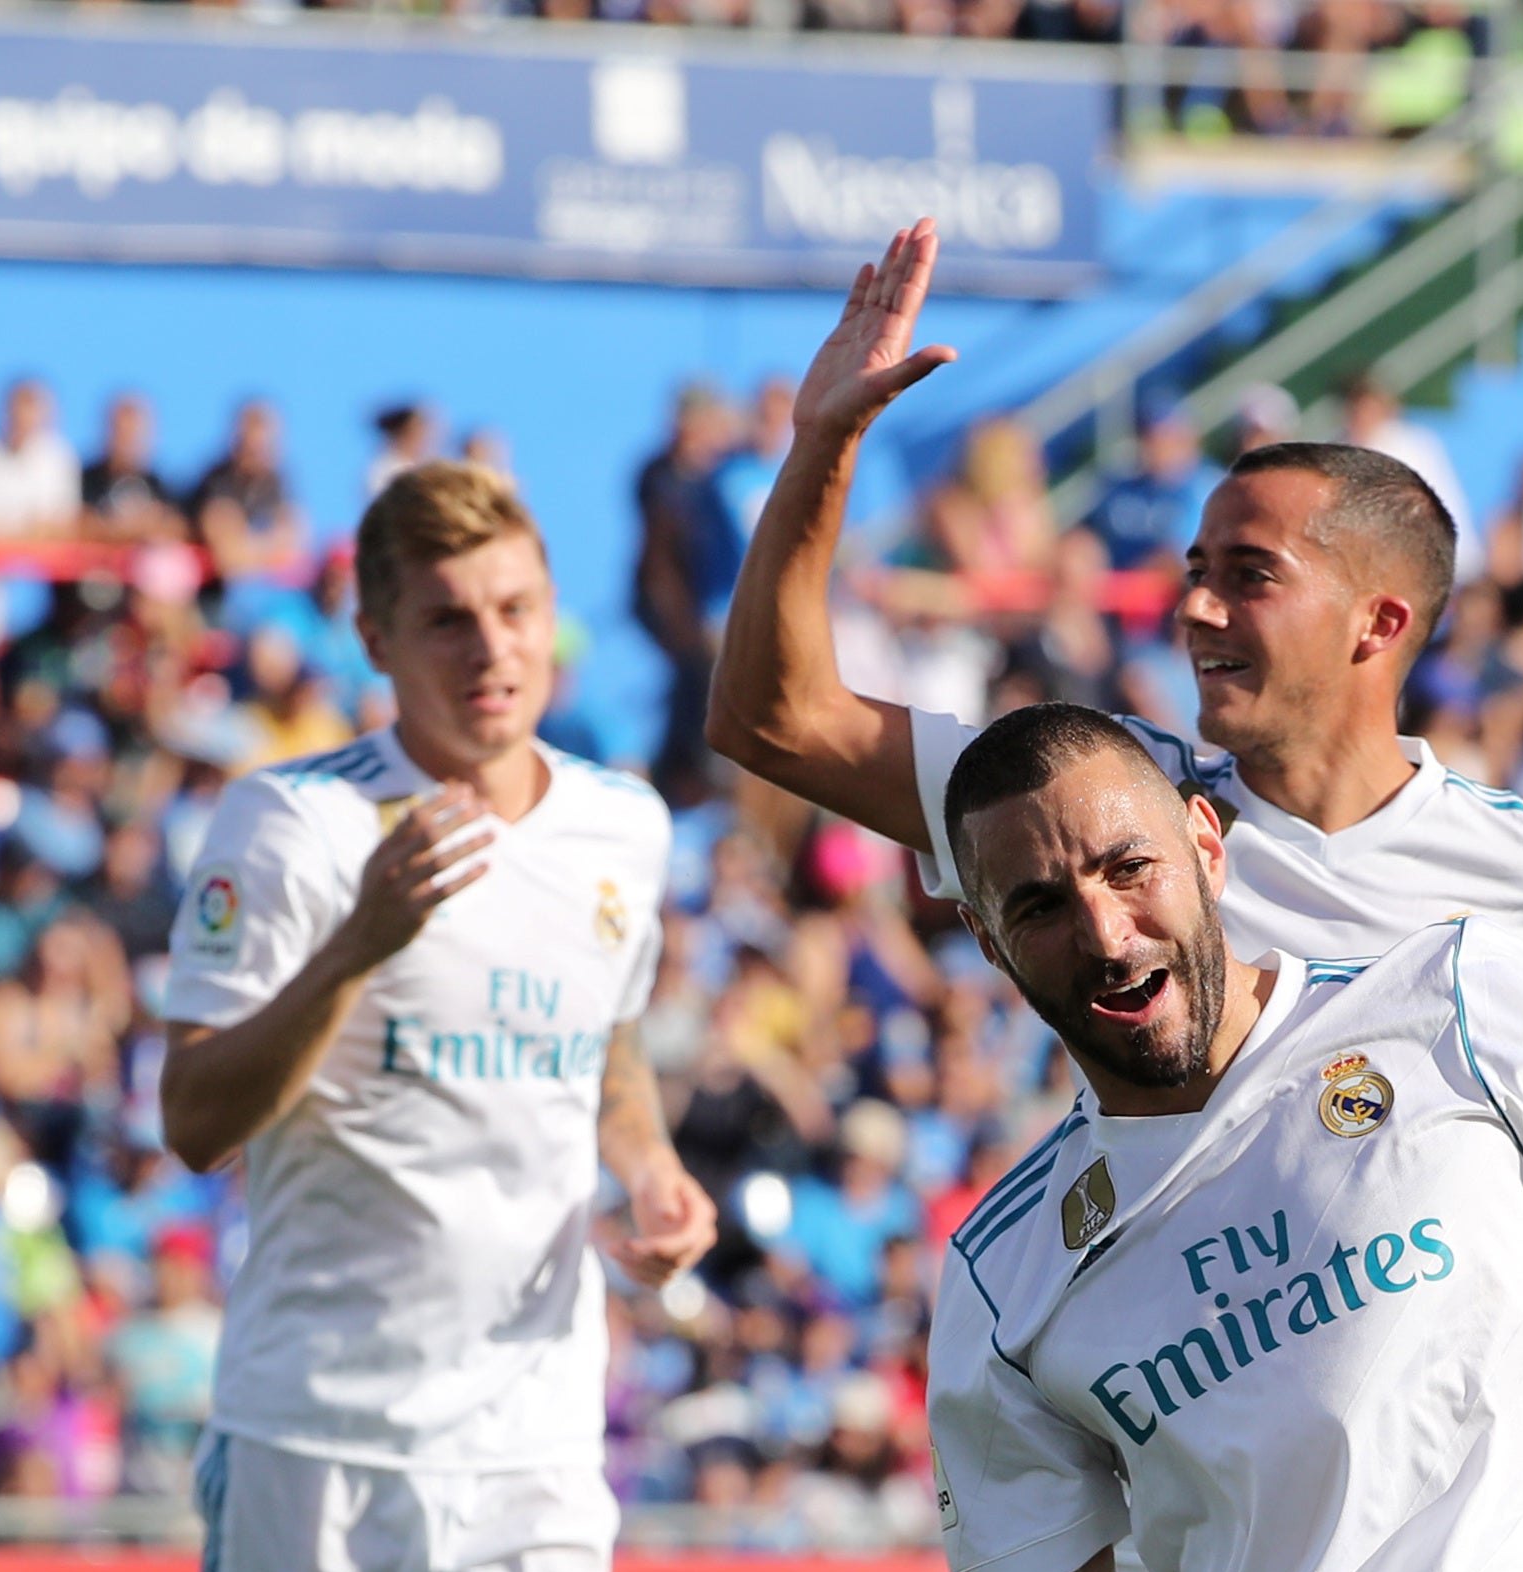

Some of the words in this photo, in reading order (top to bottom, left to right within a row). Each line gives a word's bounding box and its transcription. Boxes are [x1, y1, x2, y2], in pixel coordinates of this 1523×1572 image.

[489, 967, 560, 1021] Fly
[1181, 1209, 1291, 1295] Fly
[1089, 1217, 1455, 1446] Emirates
